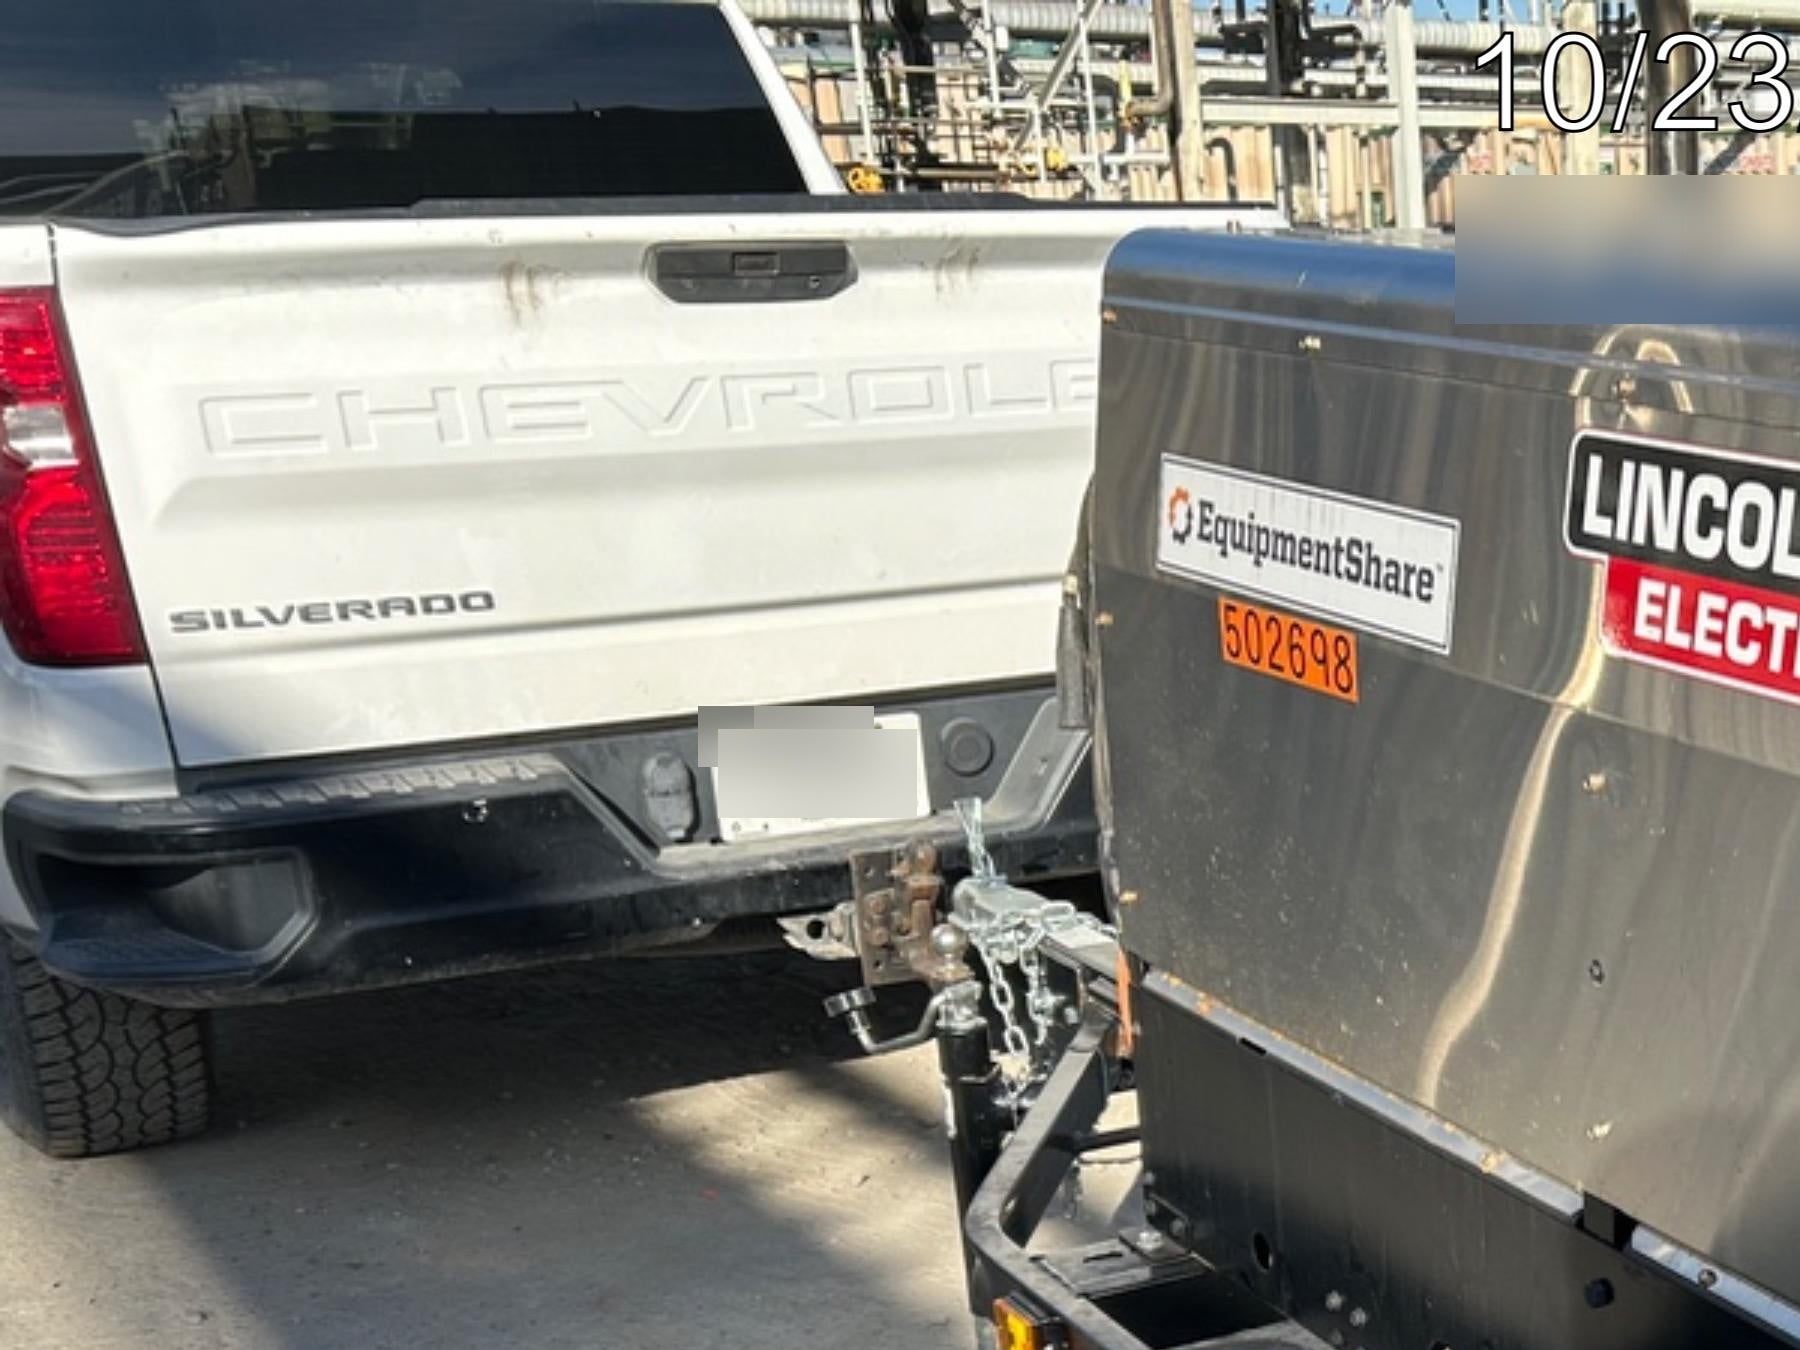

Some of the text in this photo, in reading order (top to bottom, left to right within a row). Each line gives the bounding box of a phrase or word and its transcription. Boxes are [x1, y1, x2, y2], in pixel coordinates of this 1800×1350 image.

[200, 358, 1098, 459] CHEVROLE
[169, 590, 496, 633] SILVERADO
[1223, 604, 1354, 694] 502698
